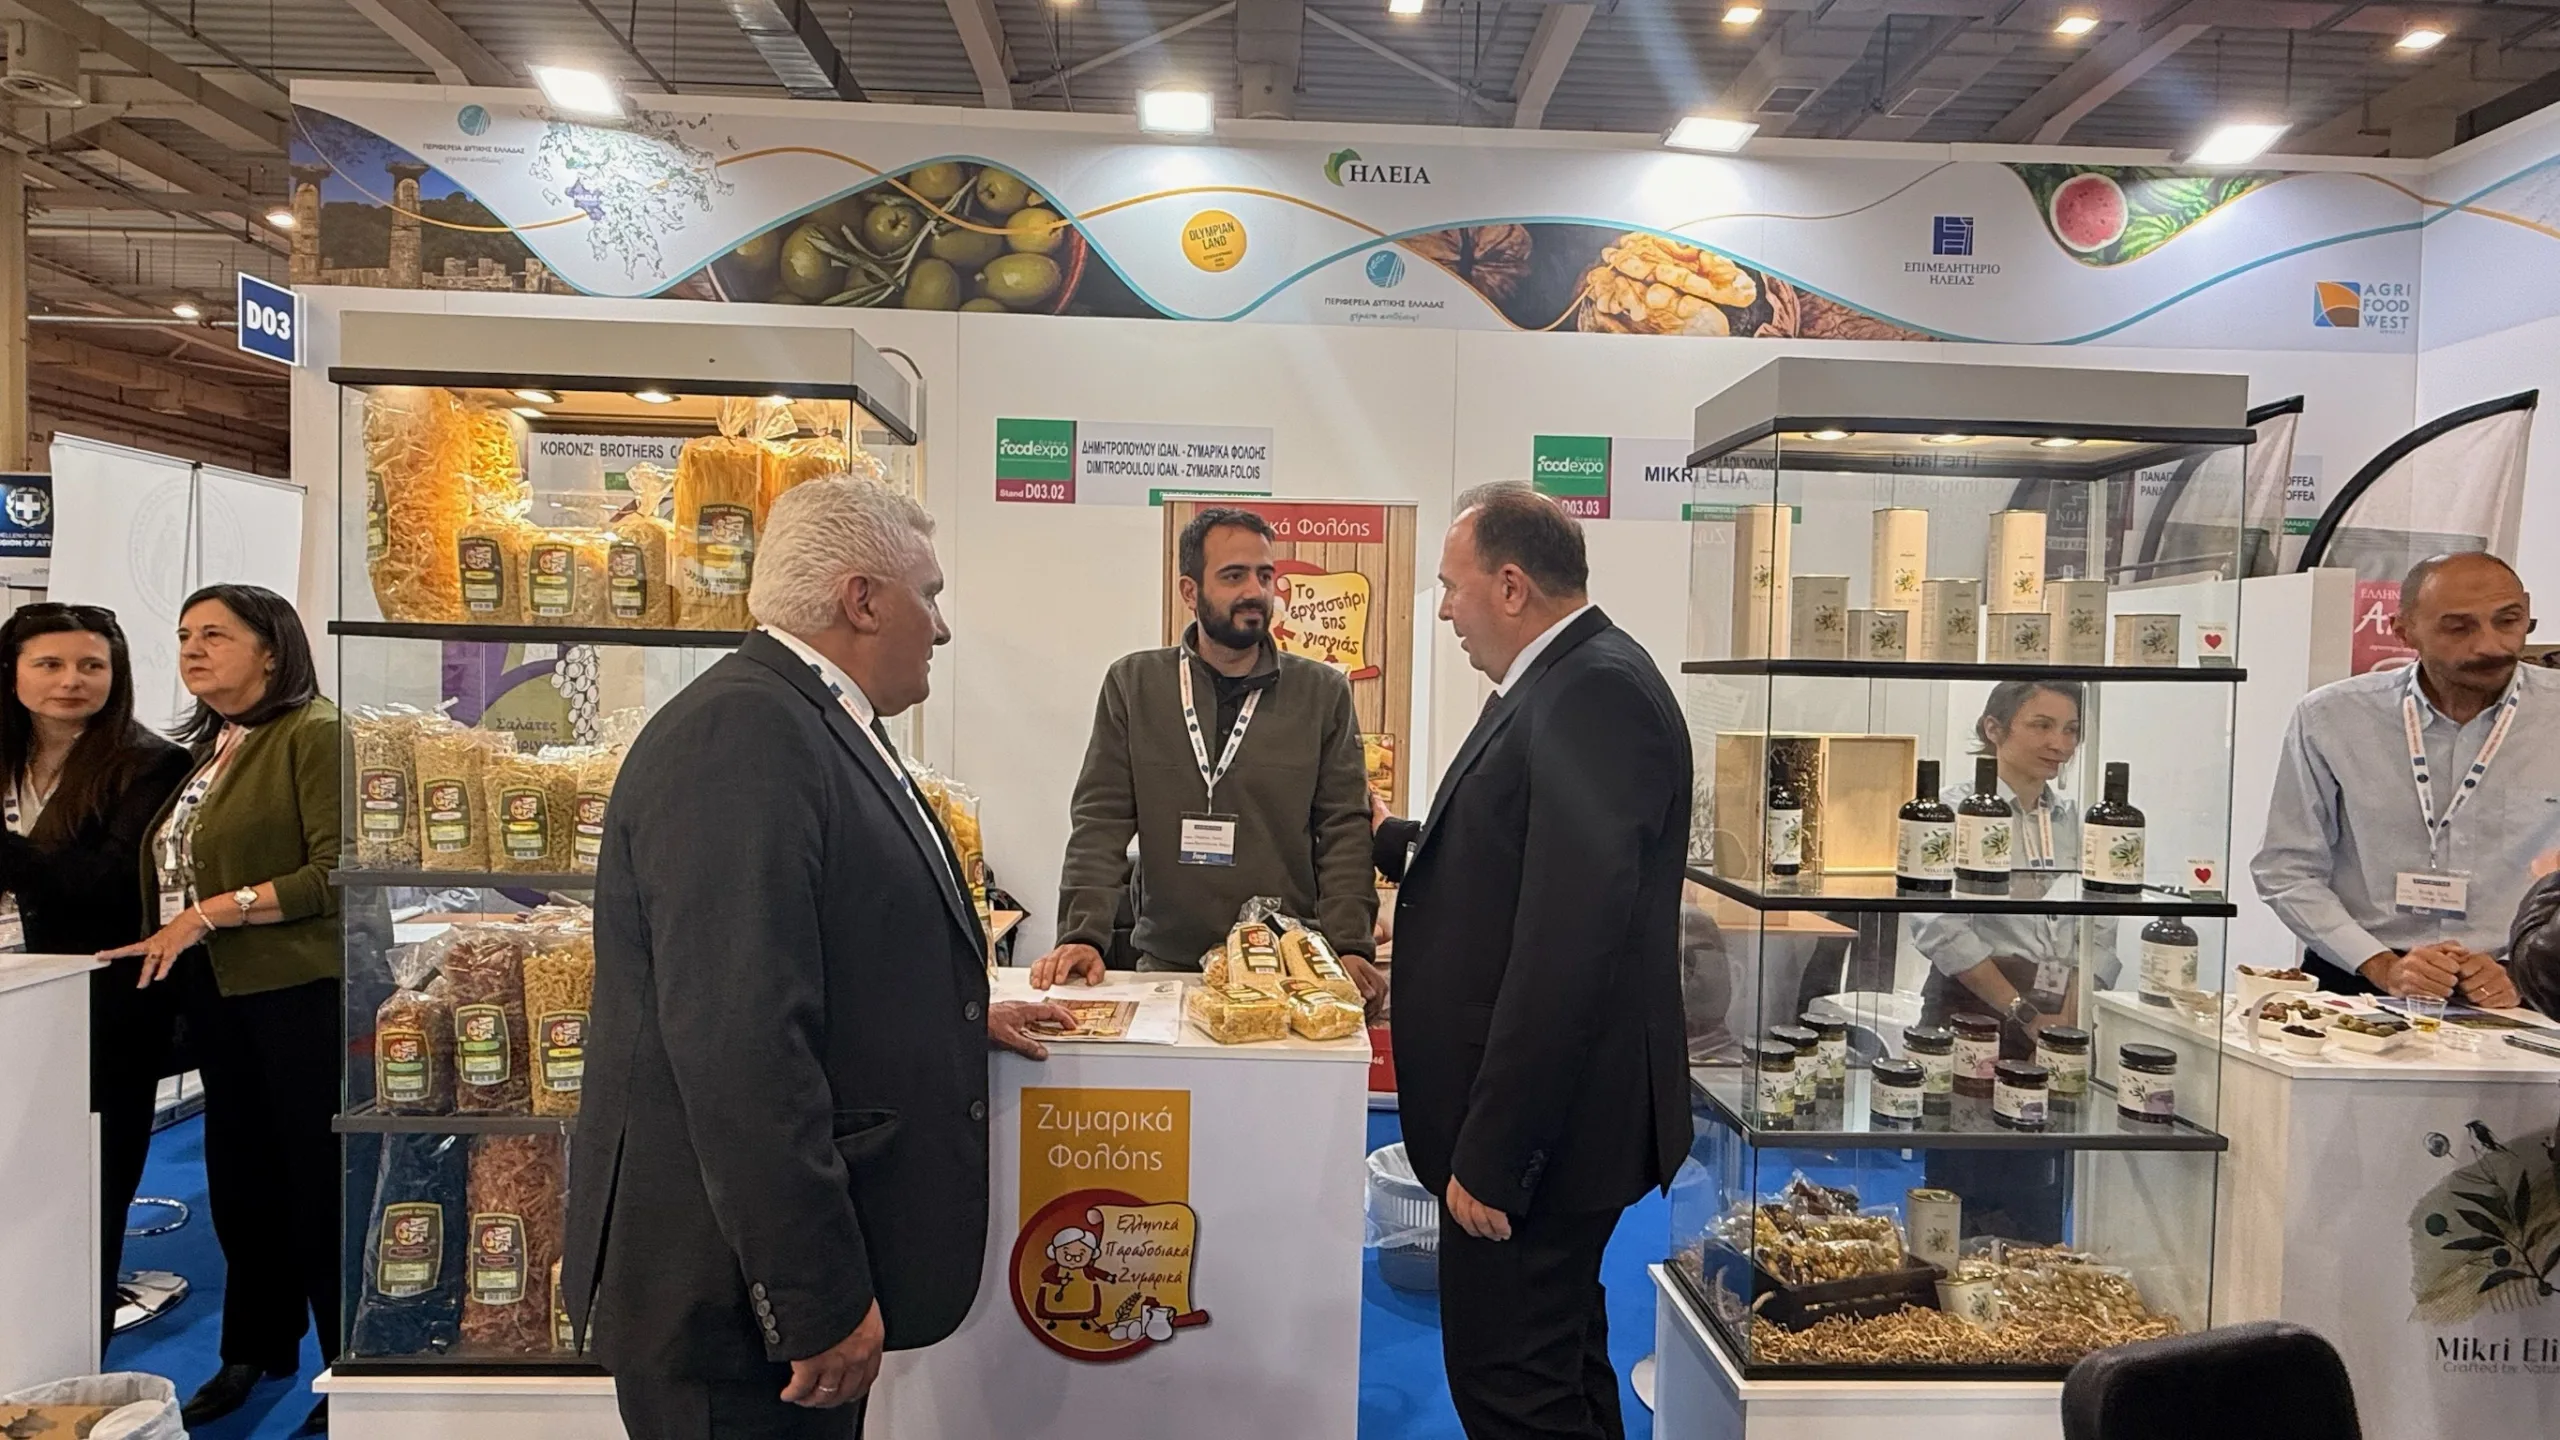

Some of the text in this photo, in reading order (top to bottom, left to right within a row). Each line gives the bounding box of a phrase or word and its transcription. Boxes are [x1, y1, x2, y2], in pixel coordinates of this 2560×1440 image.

[1350, 164, 1431, 185] ΗΛΕΙΑ
[1189, 222, 1235, 241] OLYMPIAN
[1202, 235, 1227, 249] LAND
[1904, 261, 2001, 274] ΕΠΙΜΕΛΗΤΗΡΙΟ
[1930, 275, 1974, 285] ΗΛΕΙΑΣ
[2364, 283, 2411, 296] AGRI
[1325, 298, 1370, 306] ΠΕΡΙΦΕΡΕΙΑ
[1408, 300, 1444, 308] ΕΛΛΑΔΑΣ
[2363, 299, 2410, 312] FOOD
[246, 300, 291, 340] D03
[2364, 315, 2410, 329] WEST
[600, 443, 664, 459] BROTHERS
[1000, 438, 1069, 459] foodexpo
[1082, 440, 1157, 456] ΔΗΜΗΤΡΟΠΟΥΛΟΥ
[1157, 443, 1182, 457] ΙΩΑΝ.
[1187, 444, 1230, 458] ΖΥΜΑΡΙΚΑ
[1231, 446, 1266, 460] ΦΟΛΟΗΣ
[1086, 460, 1155, 475] DIMITROPOULOU
[1157, 462, 1180, 477] IOAN.
[1186, 464, 1229, 478] ZYMARIKA
[1230, 465, 1260, 479] FOLOIS
[1537, 455, 1604, 475] foodexpo
[1644, 466, 1699, 483] MIKRI
[1000, 483, 1065, 500] Stand D03.02
[1297, 517, 1370, 536] Φολόης
[1295, 583, 1315, 599] Το
[1290, 591, 1366, 621] εργαστήρι
[1321, 615, 1347, 630] της
[1303, 631, 1360, 655] γιαγιάς
[496, 716, 558, 733] Σαλάτες
[1037, 1103, 1173, 1137] Ζυμαρικά
[1047, 1143, 1163, 1171] Φολόης
[1116, 1214, 1179, 1234] Ελληνικά
[1105, 1240, 1190, 1263] Παραδοσιακά
[1117, 1267, 1182, 1290] Ζυμαρικά
[2435, 1337, 2558, 1362] Mikri Eli
[2443, 1362, 2498, 1373] Crafted
